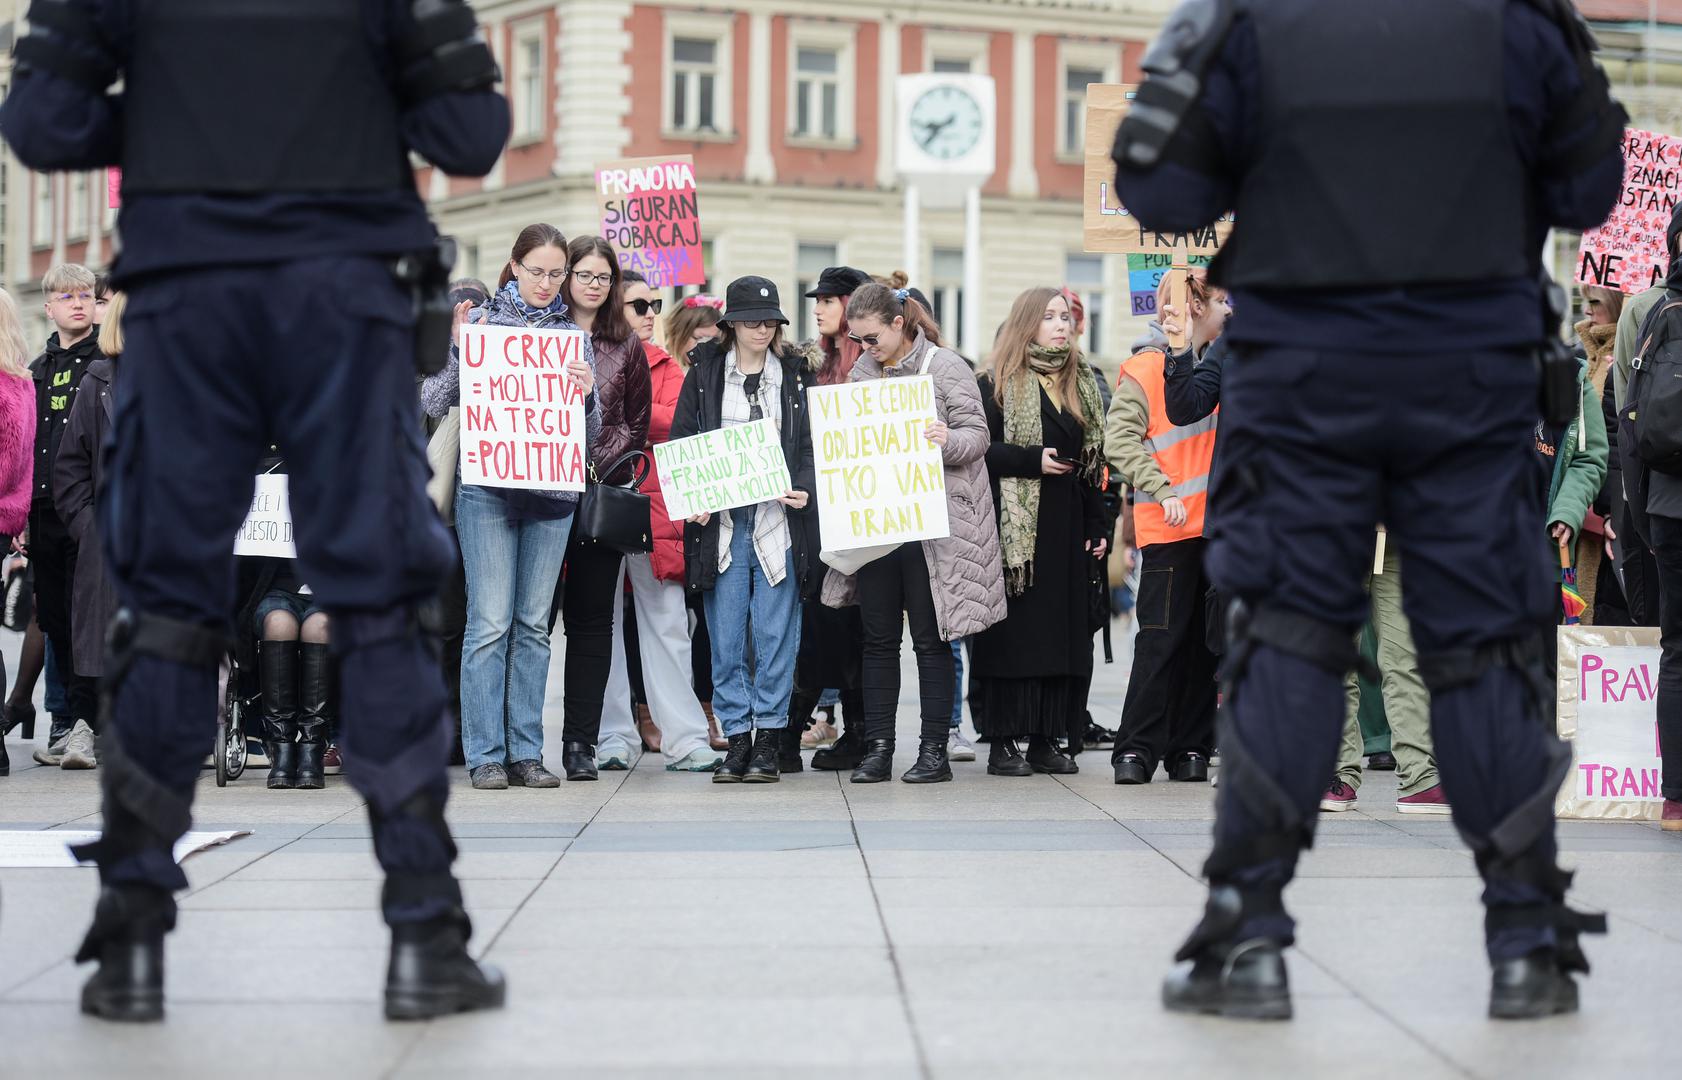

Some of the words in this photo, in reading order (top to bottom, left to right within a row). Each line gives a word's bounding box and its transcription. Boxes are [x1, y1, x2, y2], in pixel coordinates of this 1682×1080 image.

[605, 191, 698, 224] SIGURAN
[605, 219, 699, 249] POBAČAJ
[617, 246, 693, 272] PAŠAVA
[1580, 250, 1623, 289] NE
[641, 268, 685, 288] VOTE
[465, 333, 485, 368] U
[503, 334, 580, 369] CRKVI
[489, 373, 585, 406] MOLITVA
[817, 391, 841, 420] VI
[851, 386, 874, 417] SE
[879, 380, 931, 414] ČEDNO
[466, 405, 498, 432] NA
[504, 407, 571, 437] TRGU
[655, 434, 716, 469] PITAJTE
[723, 422, 766, 451] PAPU
[671, 456, 733, 491] FRANJU
[735, 452, 757, 477] ZA
[758, 445, 784, 470] ŠTO
[820, 465, 877, 505] TKO
[893, 460, 944, 496] VAM
[683, 483, 735, 514] TREBA
[737, 468, 788, 502] MOLITI
[234, 520, 278, 541] MJESTO
[850, 502, 925, 538] BRANI
[1581, 654, 1659, 703] PRAV
[1579, 763, 1664, 798] TRAN
